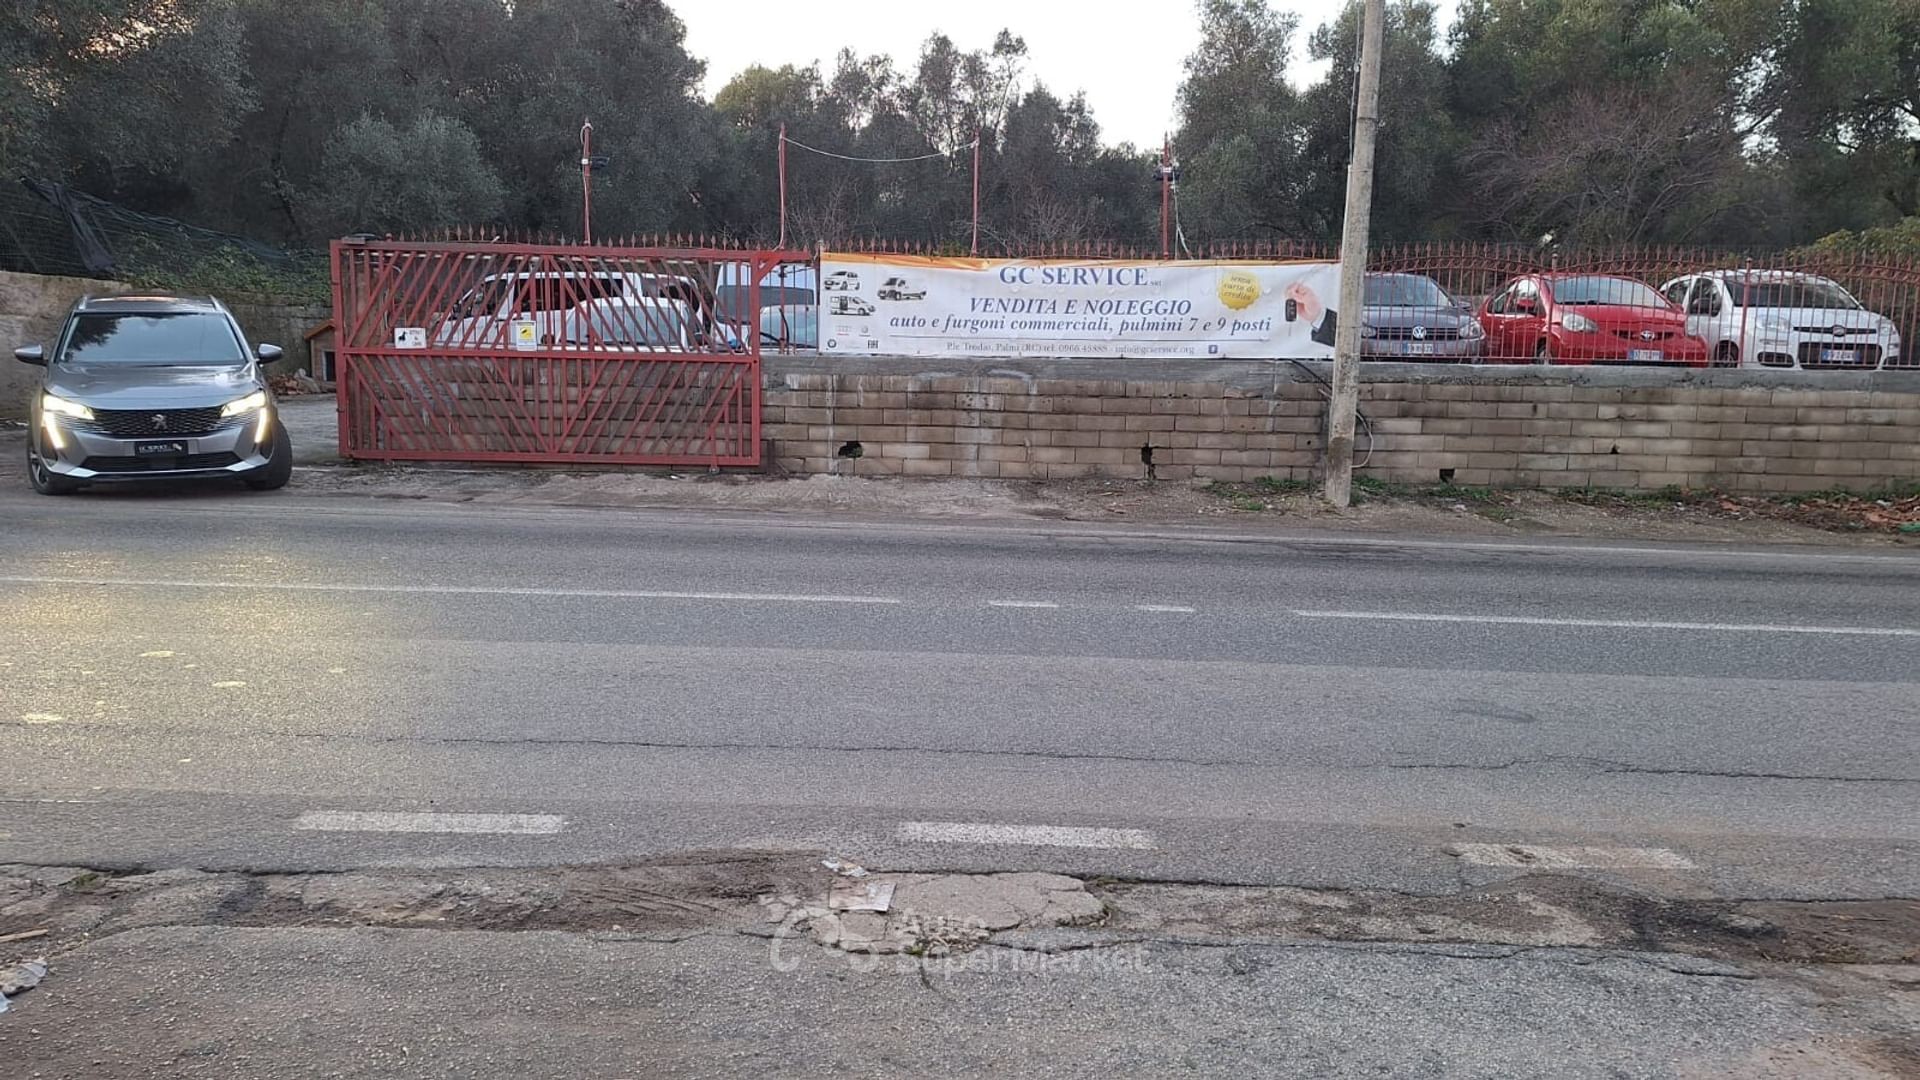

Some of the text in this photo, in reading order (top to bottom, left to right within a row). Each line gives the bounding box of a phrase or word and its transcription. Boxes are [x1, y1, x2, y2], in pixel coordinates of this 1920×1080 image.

[1000, 267, 1035, 285] GC
[1042, 267, 1148, 286] SERVICE
[969, 297, 1192, 316] VENDITA E NOLEGGIO
[890, 314, 1272, 336] auto e furgoni commerciali, pulmini 7 e 9 posti
